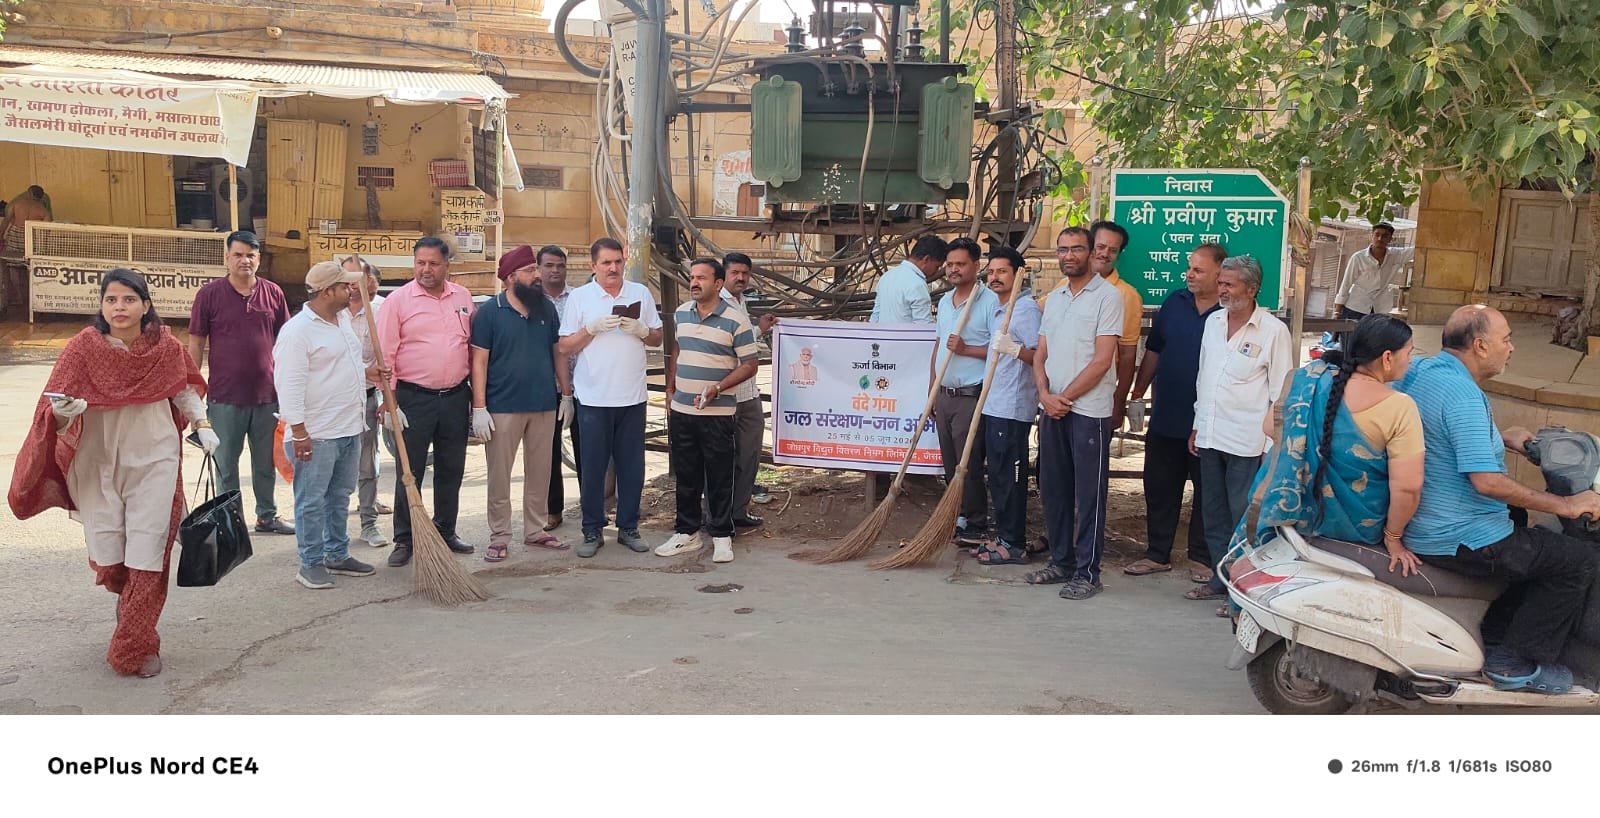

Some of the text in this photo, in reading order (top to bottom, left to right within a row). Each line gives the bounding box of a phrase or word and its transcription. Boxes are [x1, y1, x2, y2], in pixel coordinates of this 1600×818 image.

[27, 100, 67, 114] खमण
[155, 110, 197, 125] मसाला
[4, 113, 65, 132] जैसलमेरी
[108, 122, 128, 137] एवं
[129, 124, 177, 142] नमकीन
[1164, 176, 1213, 193] निवास
[1130, 202, 1277, 232] श्री प्रवीण कुमार
[317, 236, 349, 251] चाय
[1149, 247, 1180, 265] पार्षद
[35, 268, 58, 278] AMB
[59, 267, 102, 286] आन
[852, 361, 896, 371] ऊर्जा विभाग
[852, 393, 897, 413] वंदे गंगा
[784, 411, 812, 426] जल
[827, 432, 837, 440] 25
